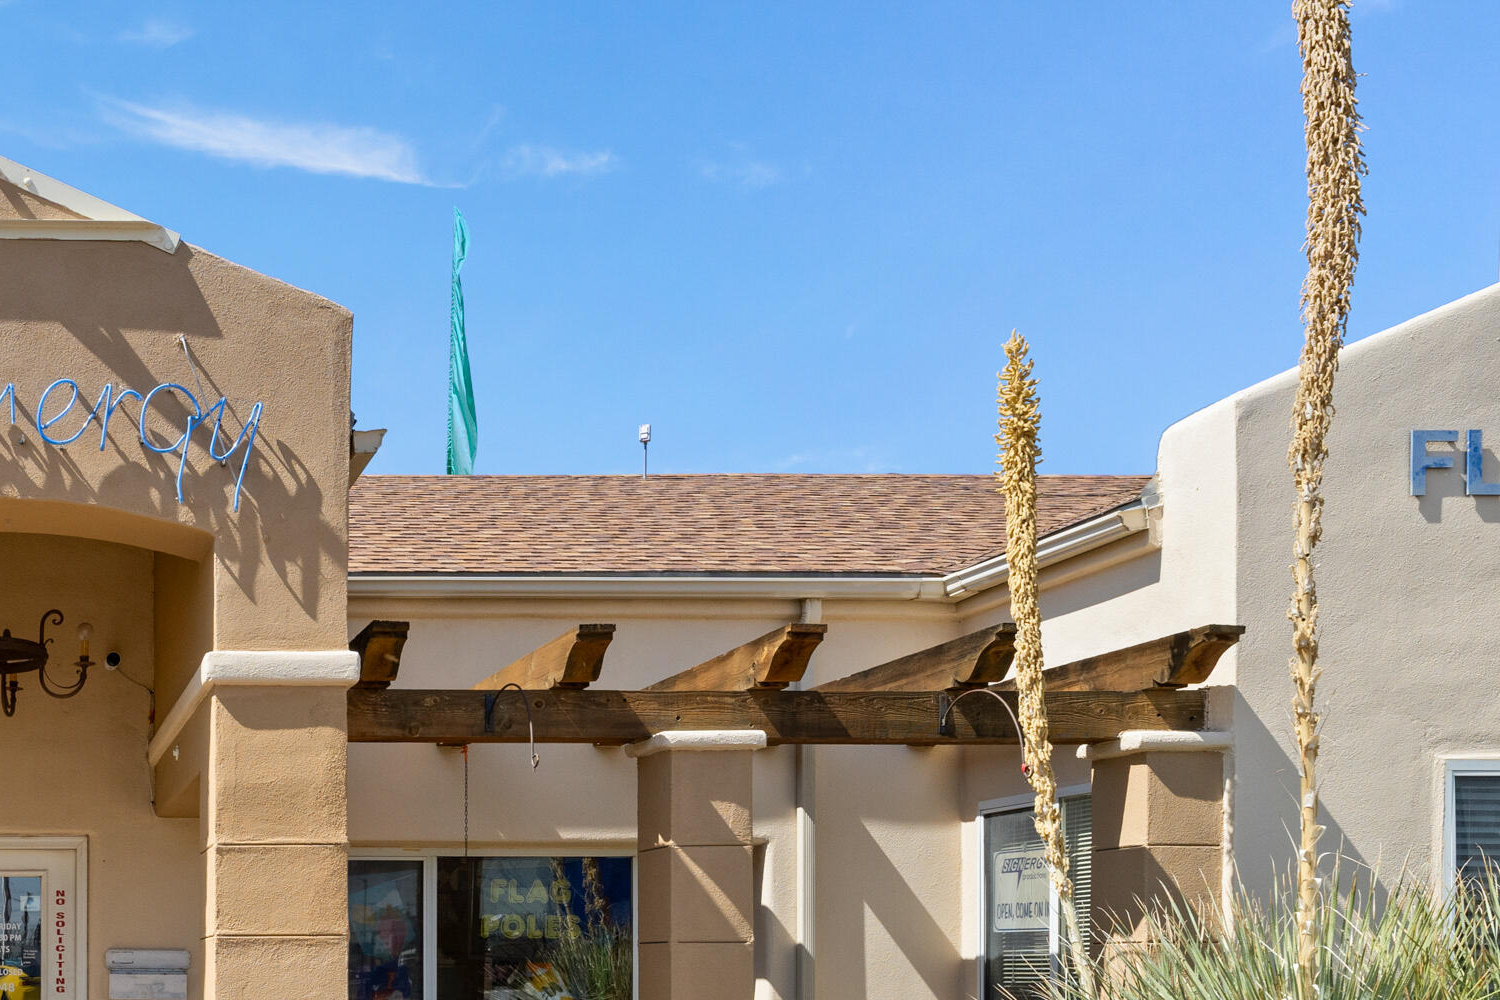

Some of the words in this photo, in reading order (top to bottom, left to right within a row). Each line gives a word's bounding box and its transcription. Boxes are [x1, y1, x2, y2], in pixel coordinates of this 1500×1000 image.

[1410, 429, 1500, 496] FL
[56, 890, 65, 906] NO
[490, 878, 571, 904] FLAG
[997, 903, 1014, 920] OPEN,
[1016, 902, 1032, 918] COME
[1034, 901, 1043, 917] ON
[9, 934, 22, 942] PM
[480, 914, 581, 940] POLES
[56, 911, 65, 993] SOLICITING
